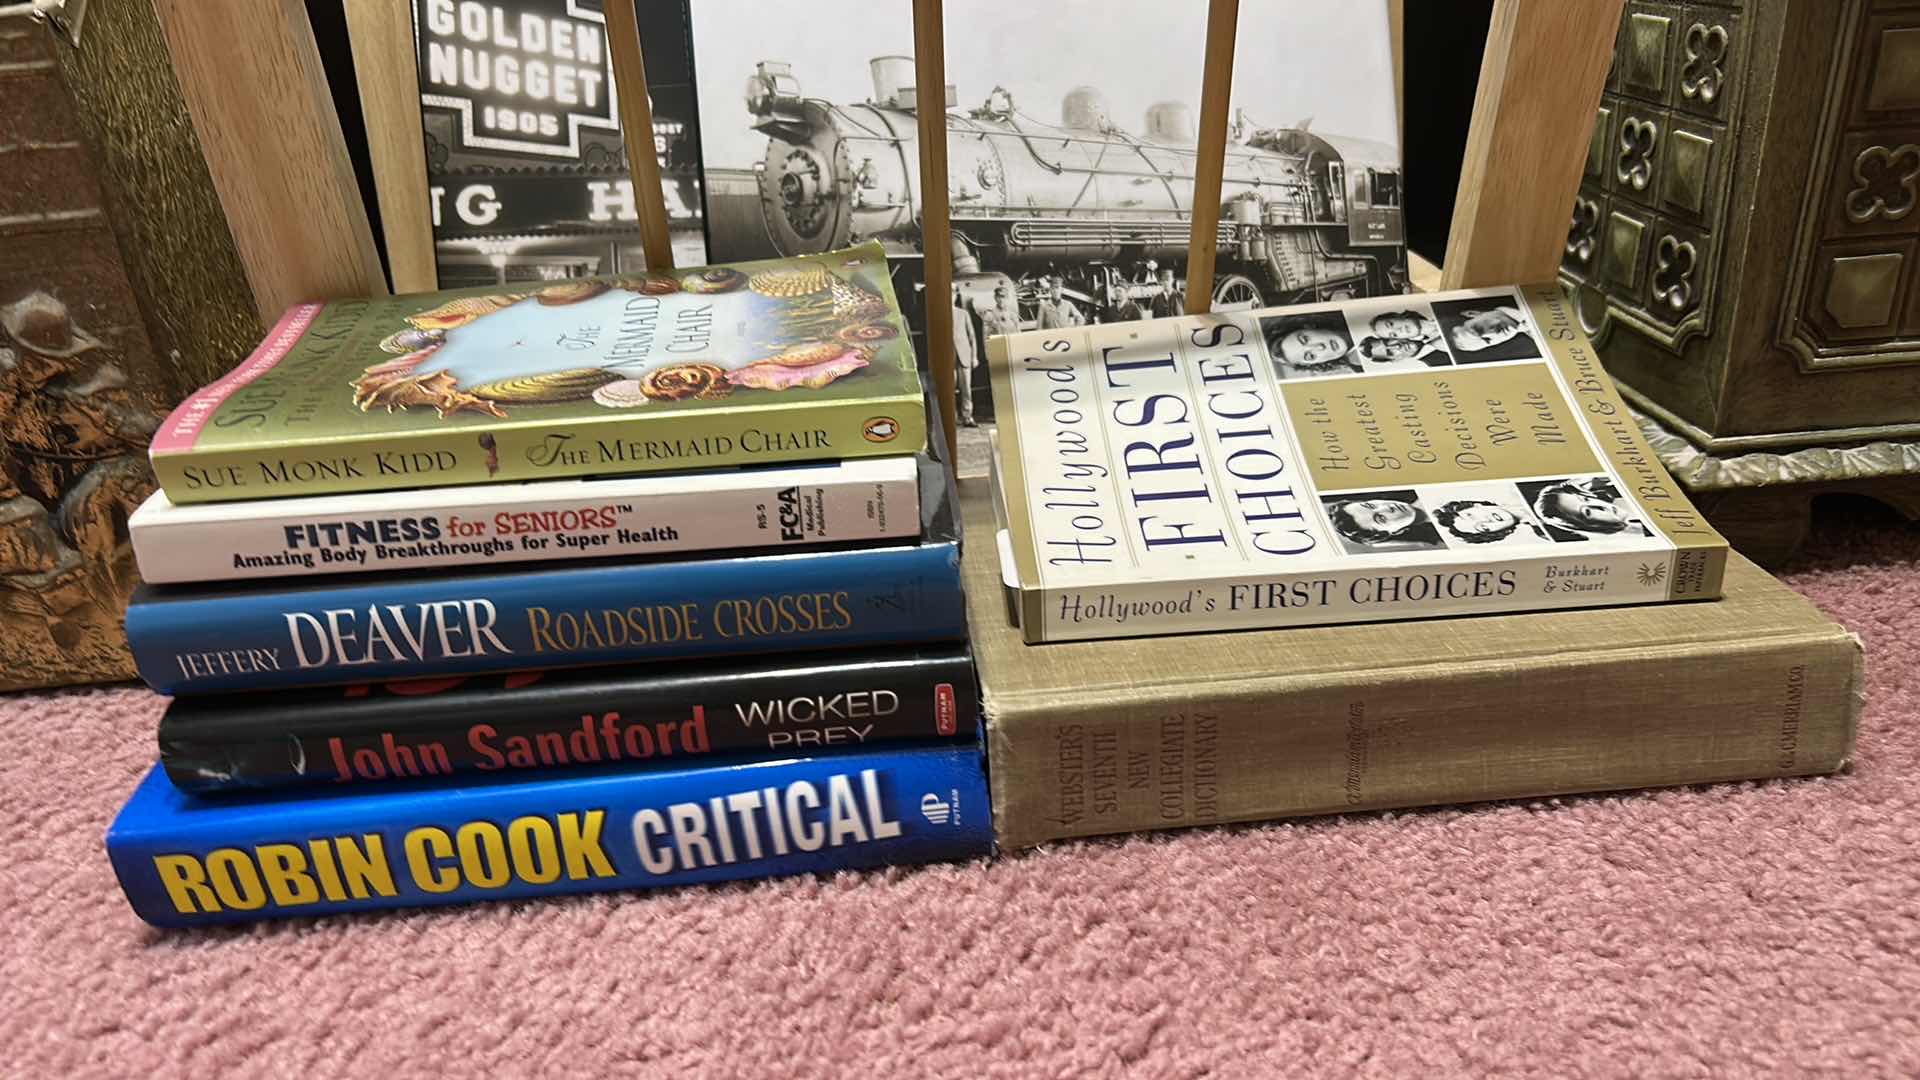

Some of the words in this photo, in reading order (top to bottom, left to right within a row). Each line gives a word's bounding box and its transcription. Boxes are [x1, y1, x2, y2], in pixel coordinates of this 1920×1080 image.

[427, 0, 600, 64] GOLDEN
[429, 42, 602, 107] NUGGET
[484, 106, 559, 137] 1905
[556, 324, 600, 350] THE
[600, 297, 661, 368] MERMAID
[665, 304, 713, 352] CHAIR
[1569, 347, 1605, 393] Bruce
[1304, 397, 1332, 424] the
[1346, 393, 1402, 470] Greatest
[1395, 393, 1437, 465] Casting
[1433, 380, 1487, 471] Decisions
[1485, 398, 1520, 447] Were
[1521, 391, 1567, 446] Made
[1588, 399, 1615, 417] &
[597, 435, 734, 462] MERMAID
[740, 427, 832, 454] CHAIR
[1026, 339, 1117, 566] Hollywood's
[1102, 346, 1227, 551] FIRST
[1191, 324, 1317, 556] CHOICES
[1319, 431, 1350, 472] How
[1603, 421, 1672, 502] Burkhart
[183, 465, 247, 490] SUE
[258, 456, 364, 485] MONK
[373, 450, 458, 475] KIDD
[284, 517, 442, 548] FITNESS
[446, 516, 486, 539] for
[778, 486, 804, 541] FC&A
[804, 495, 815, 531] Medical
[814, 488, 826, 537] Publishing
[1653, 508, 1713, 536] Jeff
[233, 551, 316, 570] Amazing
[320, 547, 367, 565] Body
[375, 537, 514, 560] Breakthroughs
[522, 533, 550, 551] for
[556, 531, 610, 551] Super
[618, 525, 679, 544] Health
[1545, 564, 1609, 578] Burkhart
[1060, 589, 1216, 623] Hollywood's
[1228, 580, 1337, 611] FIRST
[1349, 569, 1517, 604] CHOICES
[1543, 580, 1556, 593] &
[1562, 579, 1605, 592] Stuart
[175, 648, 282, 680] JEFFERY
[282, 598, 513, 670] DEAVER
[526, 603, 702, 654] ROADSIDE
[714, 591, 853, 638] CROSSES
[735, 690, 900, 728] WICKED
[938, 691, 947, 731] PUTNAM
[328, 733, 453, 783] John
[467, 705, 711, 772] Sandford
[769, 724, 874, 750] PREY
[1044, 724, 1086, 826] WEBSTER'S
[1091, 728, 1119, 814] SEVENTH
[1127, 749, 1151, 790] NEW
[1160, 712, 1185, 821] COLLEGIATE
[1192, 712, 1218, 820] DICTIONARY
[953, 788, 961, 826] PUTNAM
[153, 834, 398, 913] ROBIN
[404, 809, 616, 893] COOK
[631, 769, 902, 875] CRITICAL
